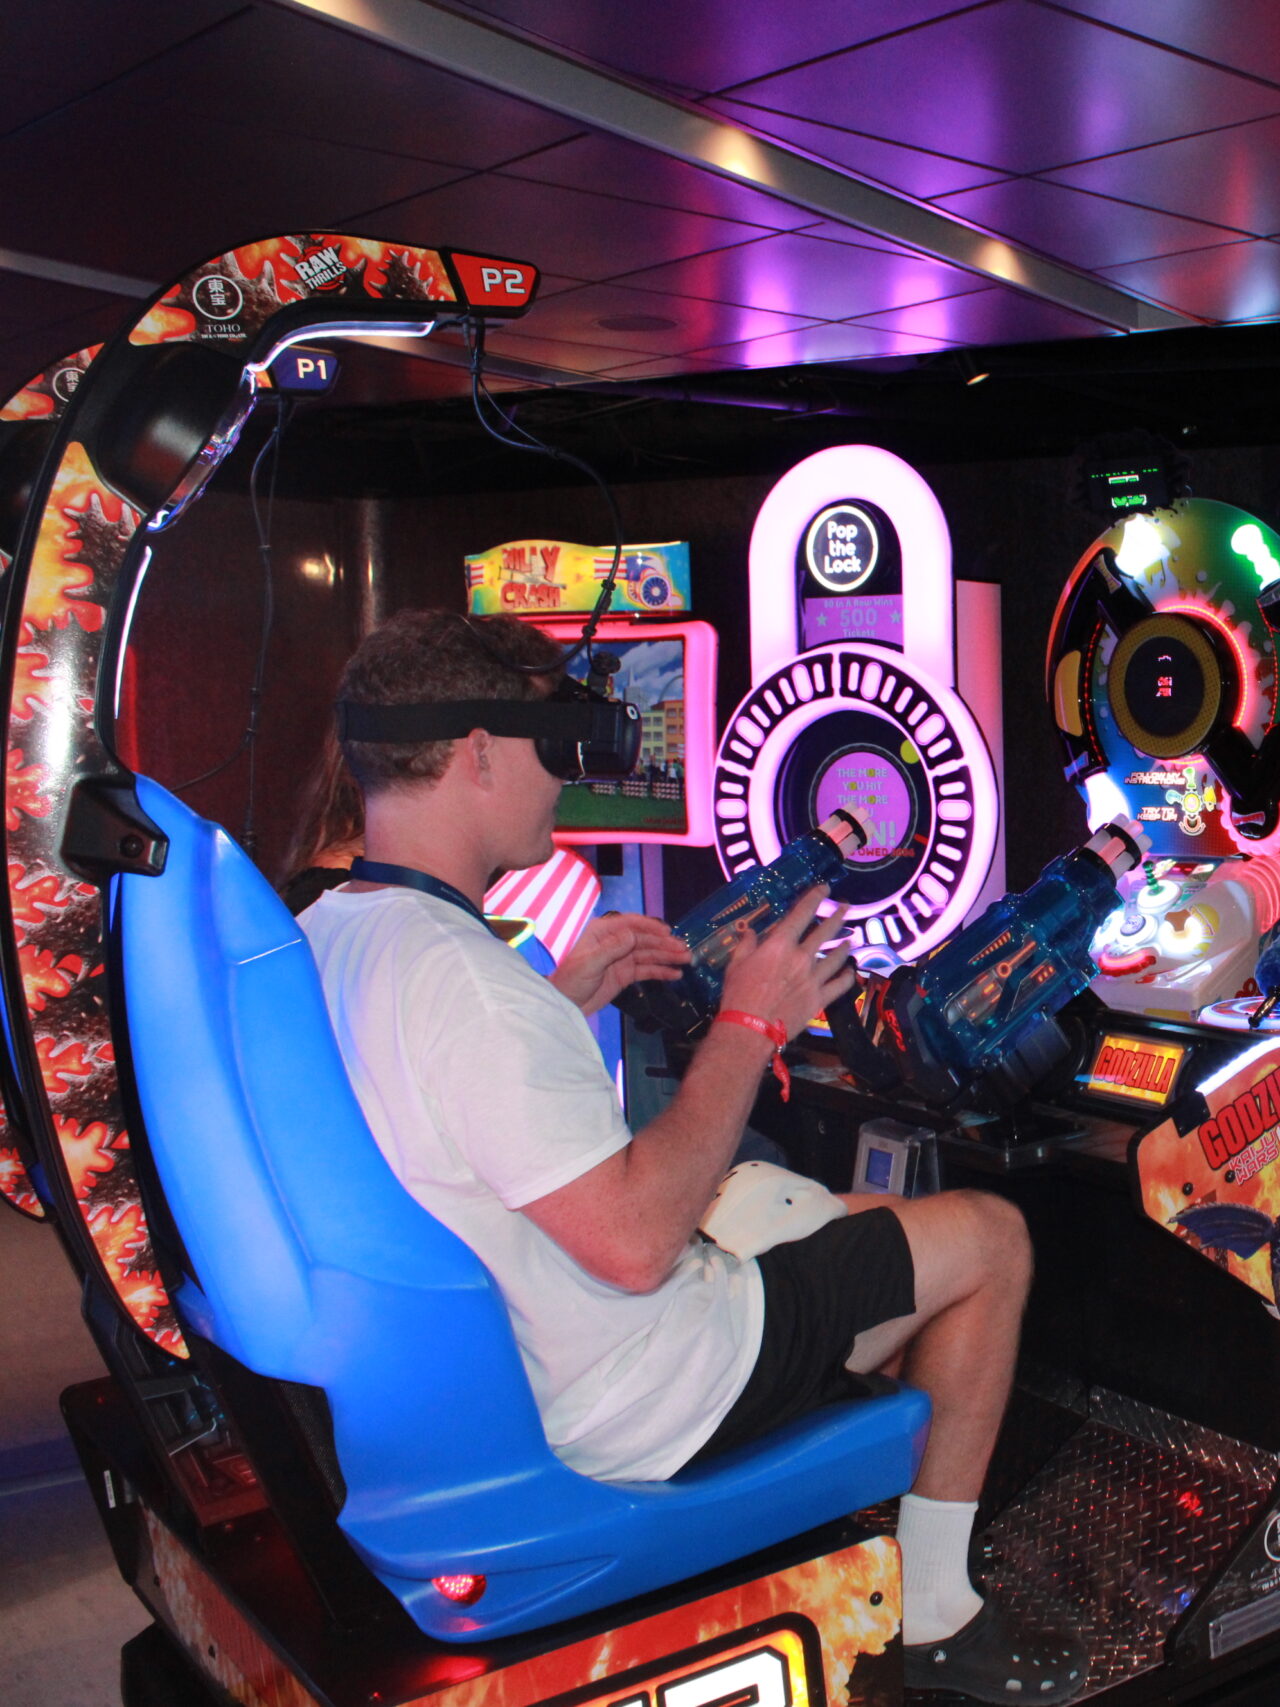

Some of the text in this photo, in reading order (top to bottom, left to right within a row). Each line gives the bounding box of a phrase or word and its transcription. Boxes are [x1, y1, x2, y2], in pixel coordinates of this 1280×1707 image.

[295, 247, 340, 280] RAW
[305, 261, 347, 290] THRILLS
[481, 267, 525, 293] P2
[207, 323, 241, 333] TOHO
[296, 357, 327, 380] P1
[827, 521, 858, 541] Pop
[828, 540, 856, 556] the
[824, 555, 861, 573] Lock
[501, 582, 561, 609] CRASH
[840, 608, 878, 627] 500
[842, 629, 875, 638] Tickets
[838, 768, 888, 778] THE MORE
[843, 781, 882, 791] YOU HIT
[838, 794, 888, 804] THE MORE
[1093, 1046, 1176, 1094] GODZILLA
[1228, 1131, 1276, 1170] KAIJU
[1235, 1145, 1279, 1185] WARS
